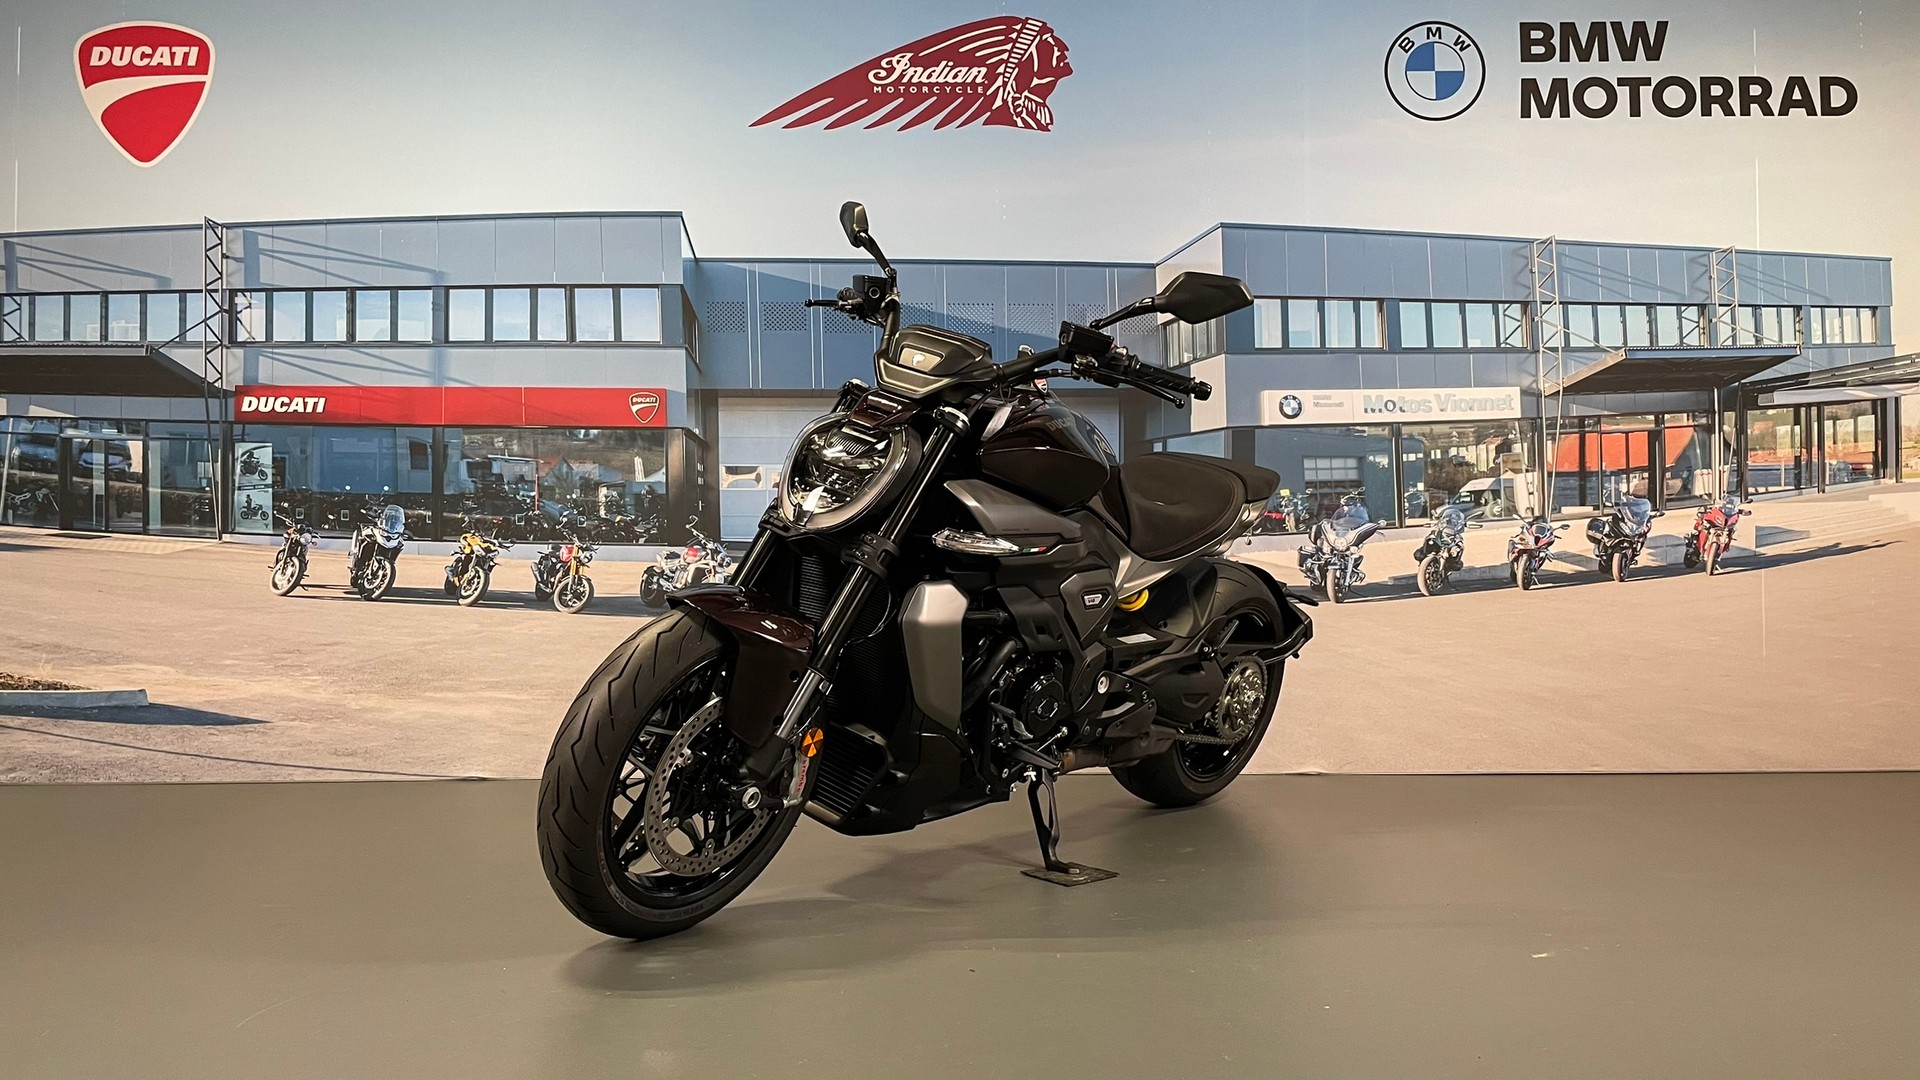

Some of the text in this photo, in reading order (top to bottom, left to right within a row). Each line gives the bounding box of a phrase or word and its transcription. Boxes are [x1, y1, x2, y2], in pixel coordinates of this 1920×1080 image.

[1398, 26, 1471, 54] BMW
[1519, 20, 1669, 63] BMW
[89, 45, 199, 67] DUCATI
[868, 52, 986, 85] Indian
[873, 85, 984, 94] MOTORCYCLE
[1519, 75, 1859, 119] MOTORRAD
[241, 396, 325, 413] DUCATI
[1363, 393, 1514, 413] Motos Vionnet
